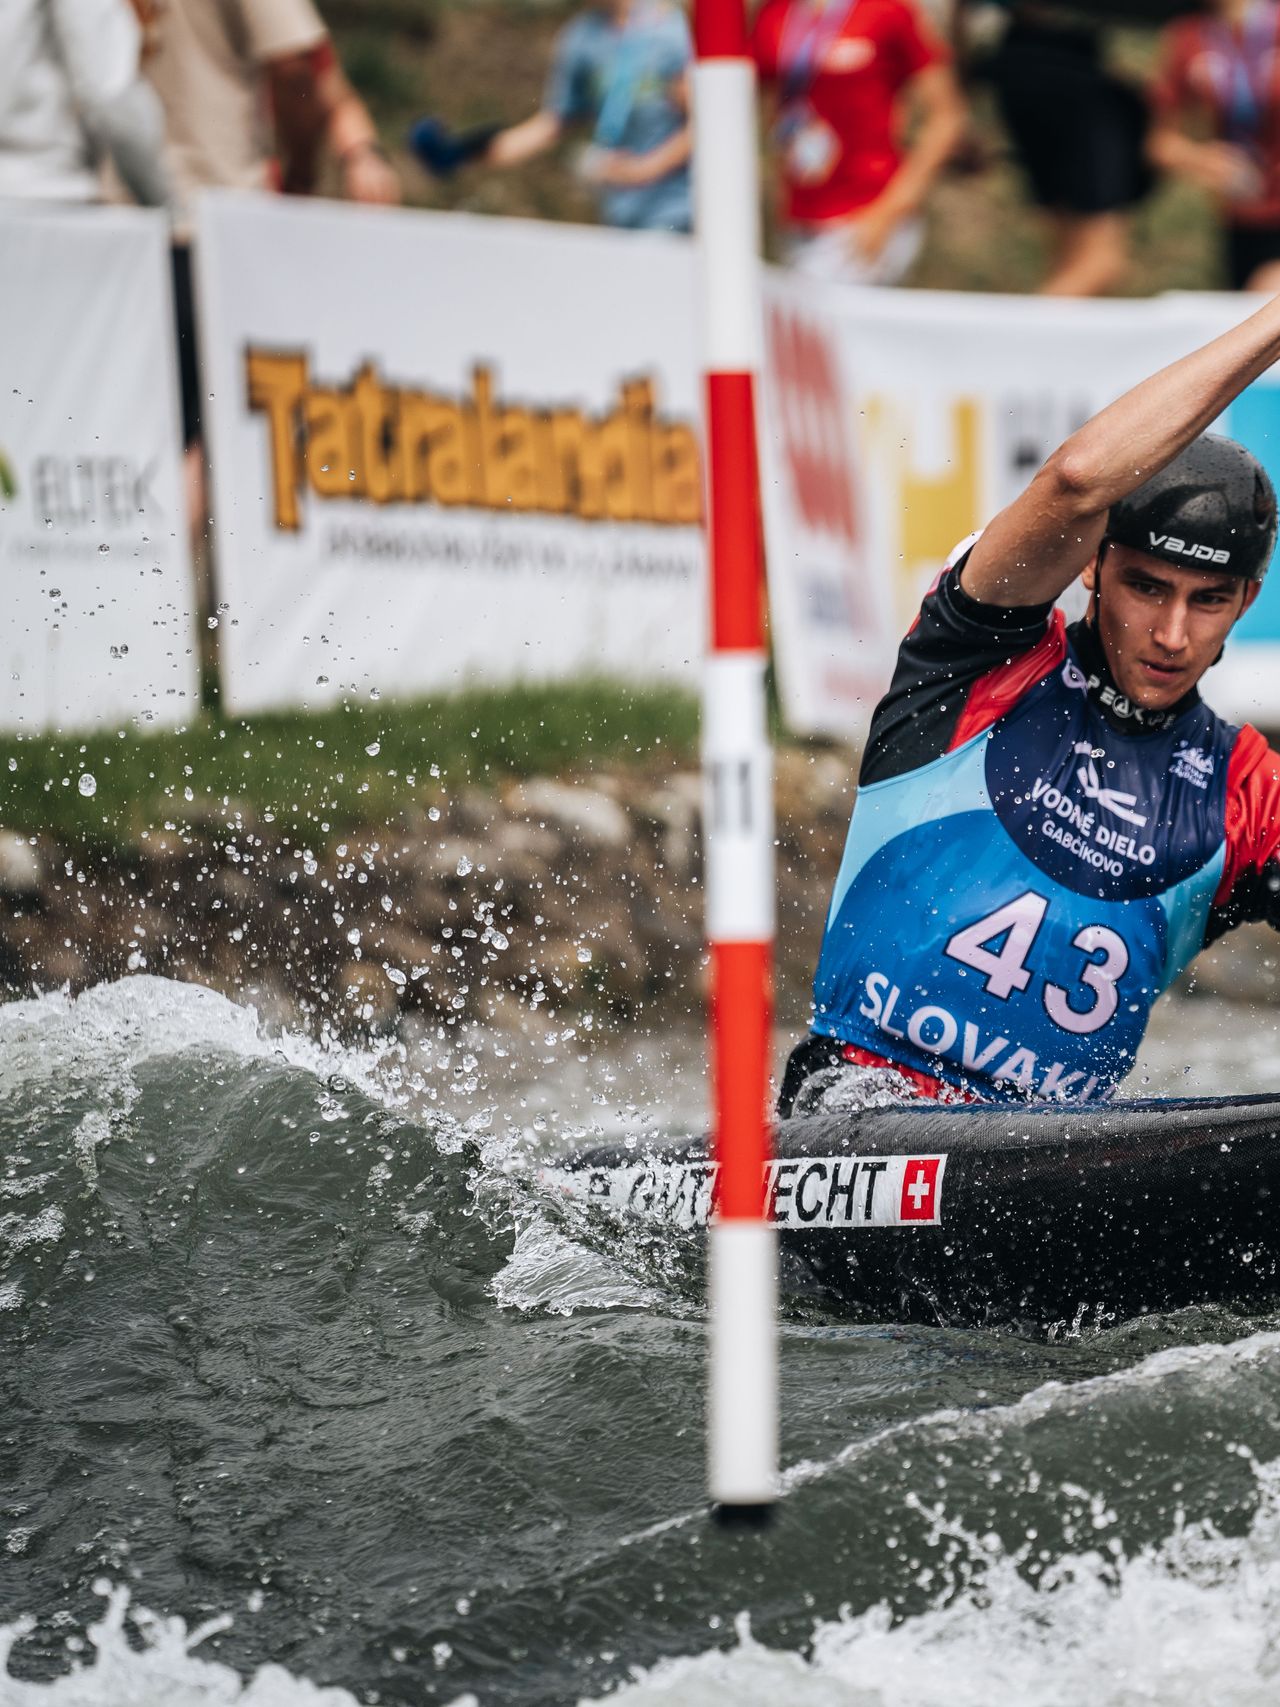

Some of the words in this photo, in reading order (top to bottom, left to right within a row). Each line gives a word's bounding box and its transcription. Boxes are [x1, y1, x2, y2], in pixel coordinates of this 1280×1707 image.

[244, 342, 706, 532] Tatralandia
[1149, 531, 1231, 565] VAJDA
[1031, 777, 1095, 837] VODNÉ
[1094, 825, 1156, 866] DIELO
[1041, 820, 1124, 877] GABČÍKOVO
[943, 890, 1129, 1034] 43
[859, 972, 1117, 1100] SLOVAKI
